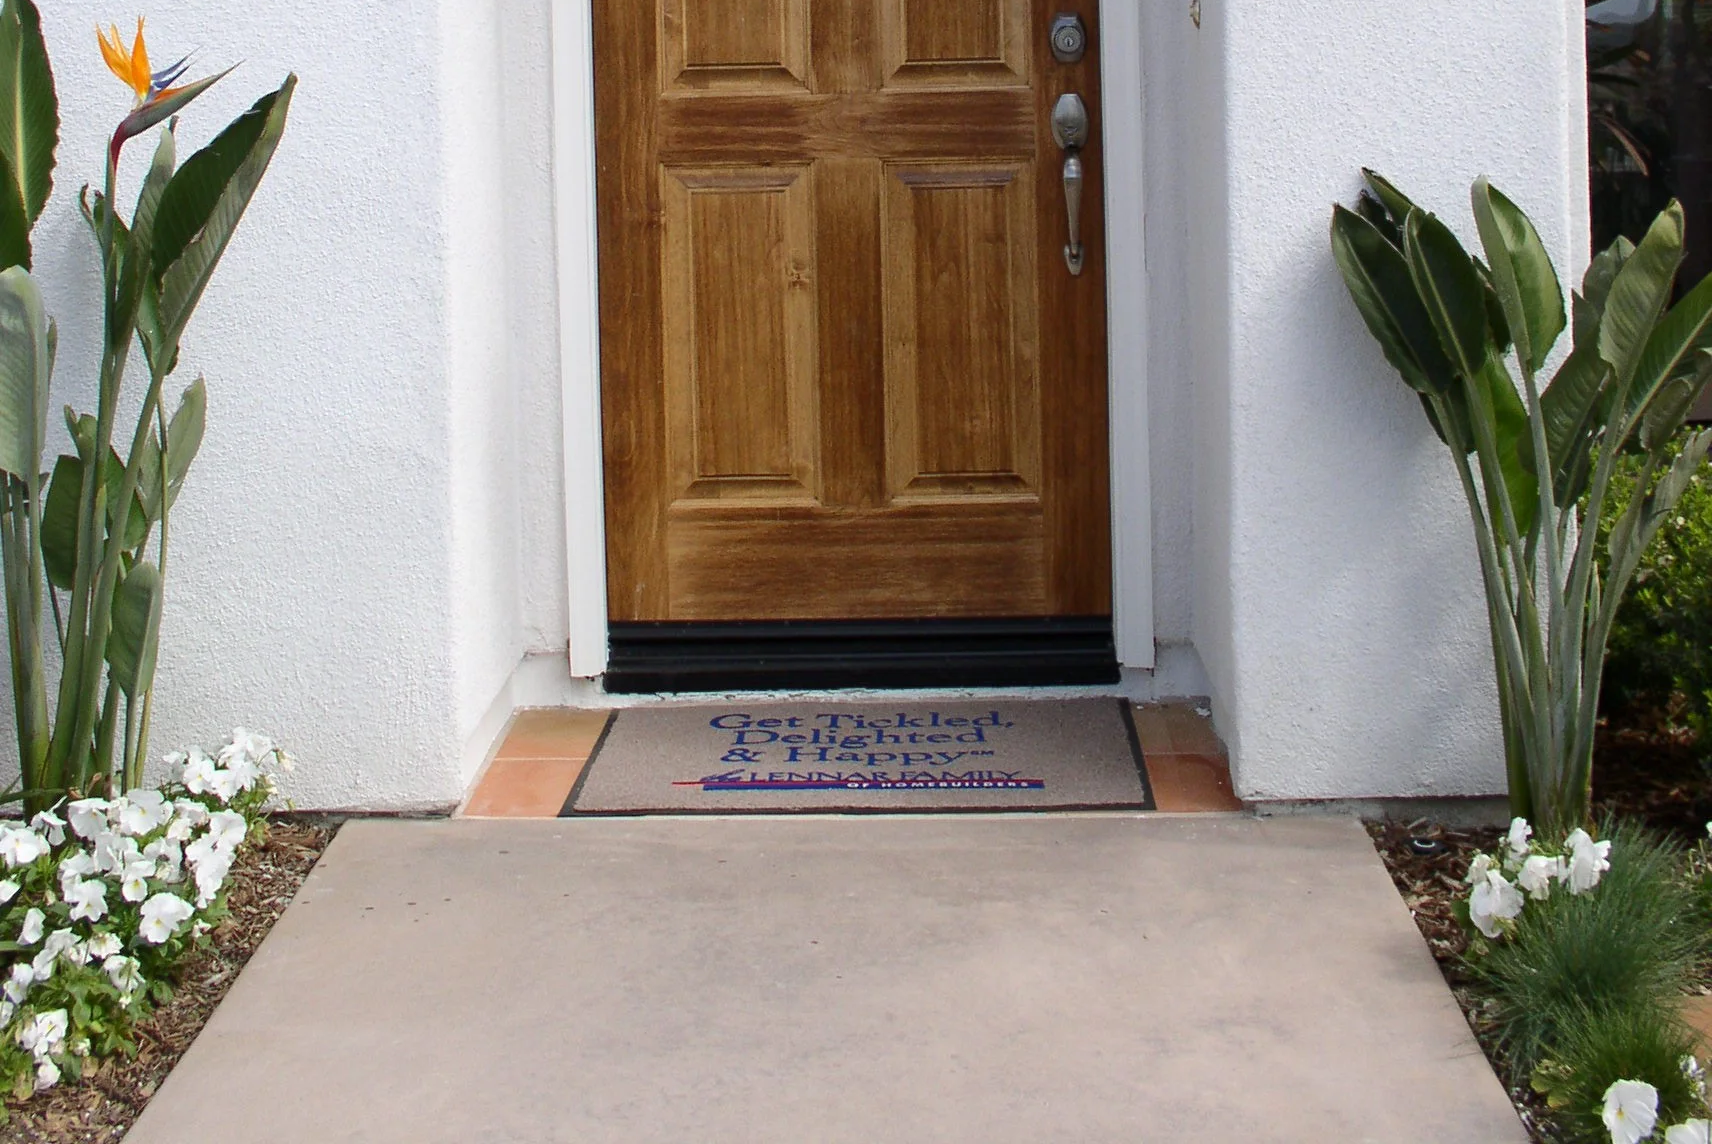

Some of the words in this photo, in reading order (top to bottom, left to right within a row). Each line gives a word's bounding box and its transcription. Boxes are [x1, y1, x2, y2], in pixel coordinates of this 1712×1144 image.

[709, 713, 803, 729] Get
[815, 711, 1014, 729] Tickled,
[731, 727, 987, 749] Delighted
[720, 748, 766, 763] &
[751, 771, 889, 783] LENNAR
[901, 770, 1021, 782] FAMILY
